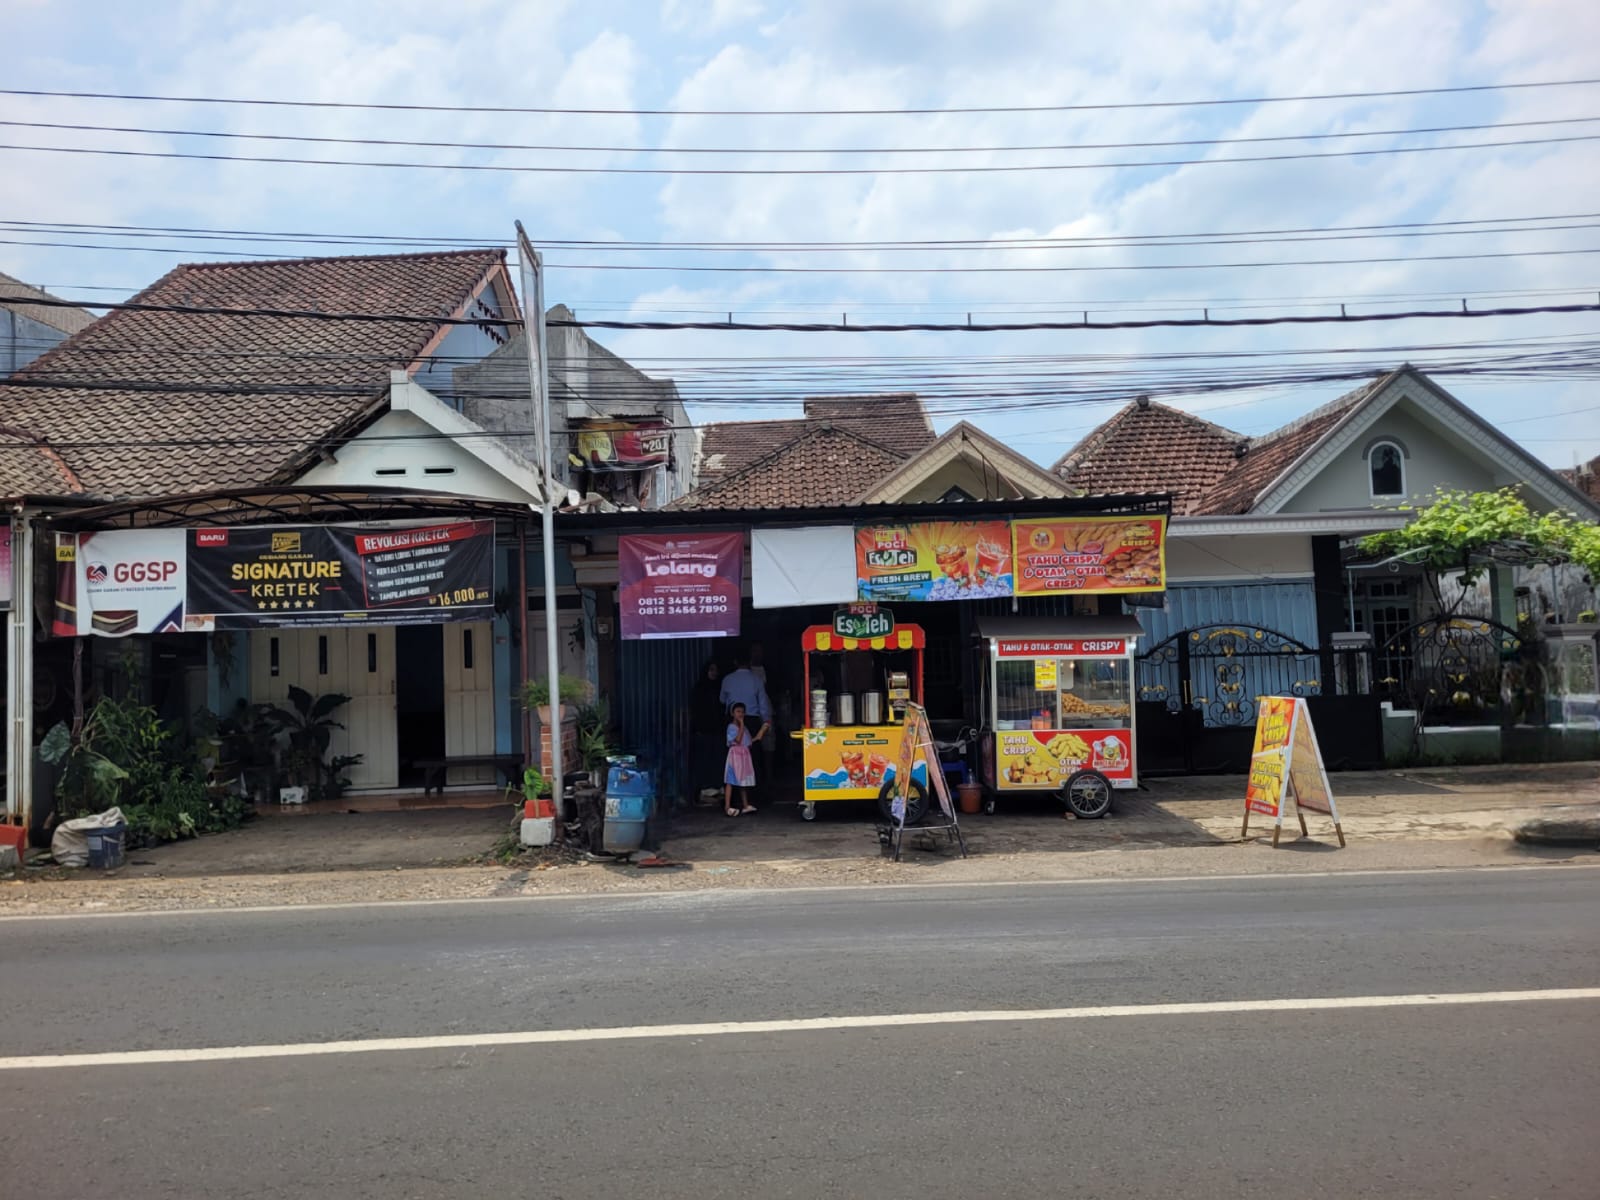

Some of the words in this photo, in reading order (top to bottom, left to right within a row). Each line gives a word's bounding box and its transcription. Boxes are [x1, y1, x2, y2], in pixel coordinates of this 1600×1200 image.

[363, 533, 410, 551] REVOLUSI
[411, 528, 450, 545] KRETEK
[878, 541, 904, 549] POCI
[888, 550, 914, 565] Teh
[1029, 556, 1059, 565] TAHU
[1061, 555, 1101, 565] CRISPY
[113, 560, 178, 583] GGSP
[231, 560, 342, 580] SIGNATURE
[645, 560, 717, 578] Lelang
[1035, 567, 1067, 578] OTAK
[1075, 566, 1106, 576] OTAK
[872, 575, 901, 584] FRESH
[903, 572, 930, 582] BREW
[1045, 578, 1085, 588] CRISPY
[251, 582, 320, 597] KRETEK
[438, 587, 475, 606] 16.000
[638, 597, 665, 606] 0812
[667, 596, 697, 605] 3456
[698, 594, 727, 604] 7890
[638, 607, 665, 616] 0812
[667, 605, 697, 615] 3456
[698, 604, 727, 614] 7890
[850, 605, 876, 614] POCI
[836, 615, 854, 634] Es
[862, 613, 889, 634] Teh
[1002, 643, 1022, 652] TAHU
[1082, 641, 1120, 652] CRISPY
[1003, 736, 1028, 745] TAHU
[1003, 746, 1037, 756] CRISPY
